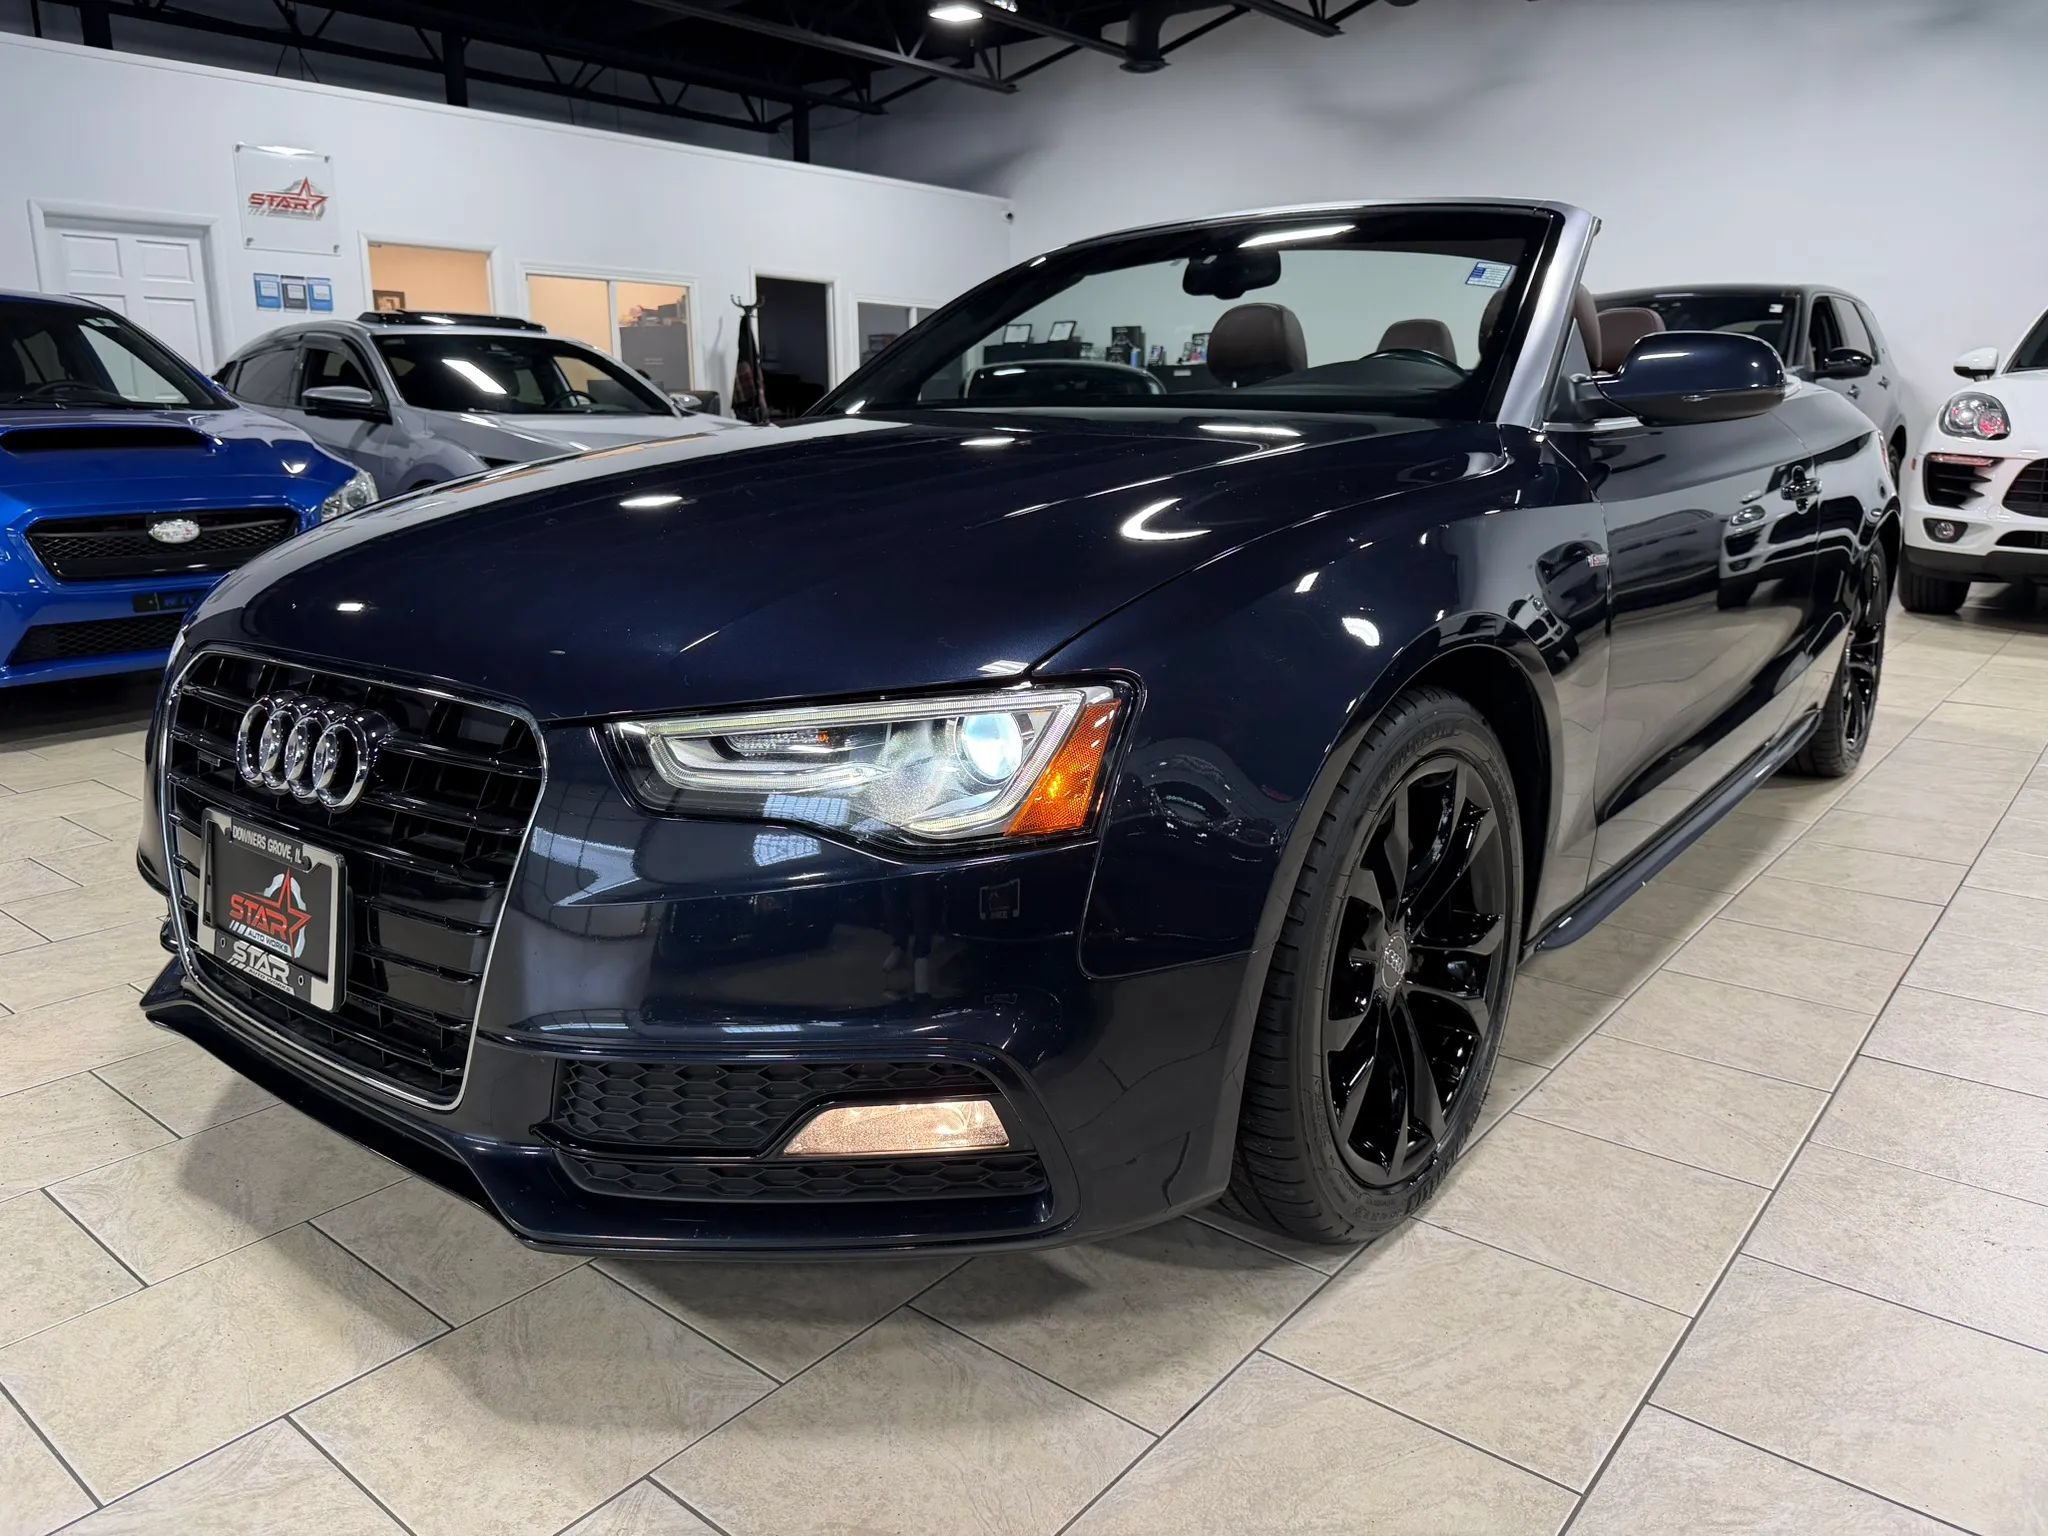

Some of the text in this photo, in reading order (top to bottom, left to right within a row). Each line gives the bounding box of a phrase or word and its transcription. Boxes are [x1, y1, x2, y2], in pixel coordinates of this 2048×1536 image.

[249, 192, 309, 210] STAR
[232, 824, 302, 864] DOWNERS GROVE, IL
[229, 894, 288, 941] STAR
[248, 930, 289, 953] AUTO WORKS
[231, 940, 290, 985] STAR
